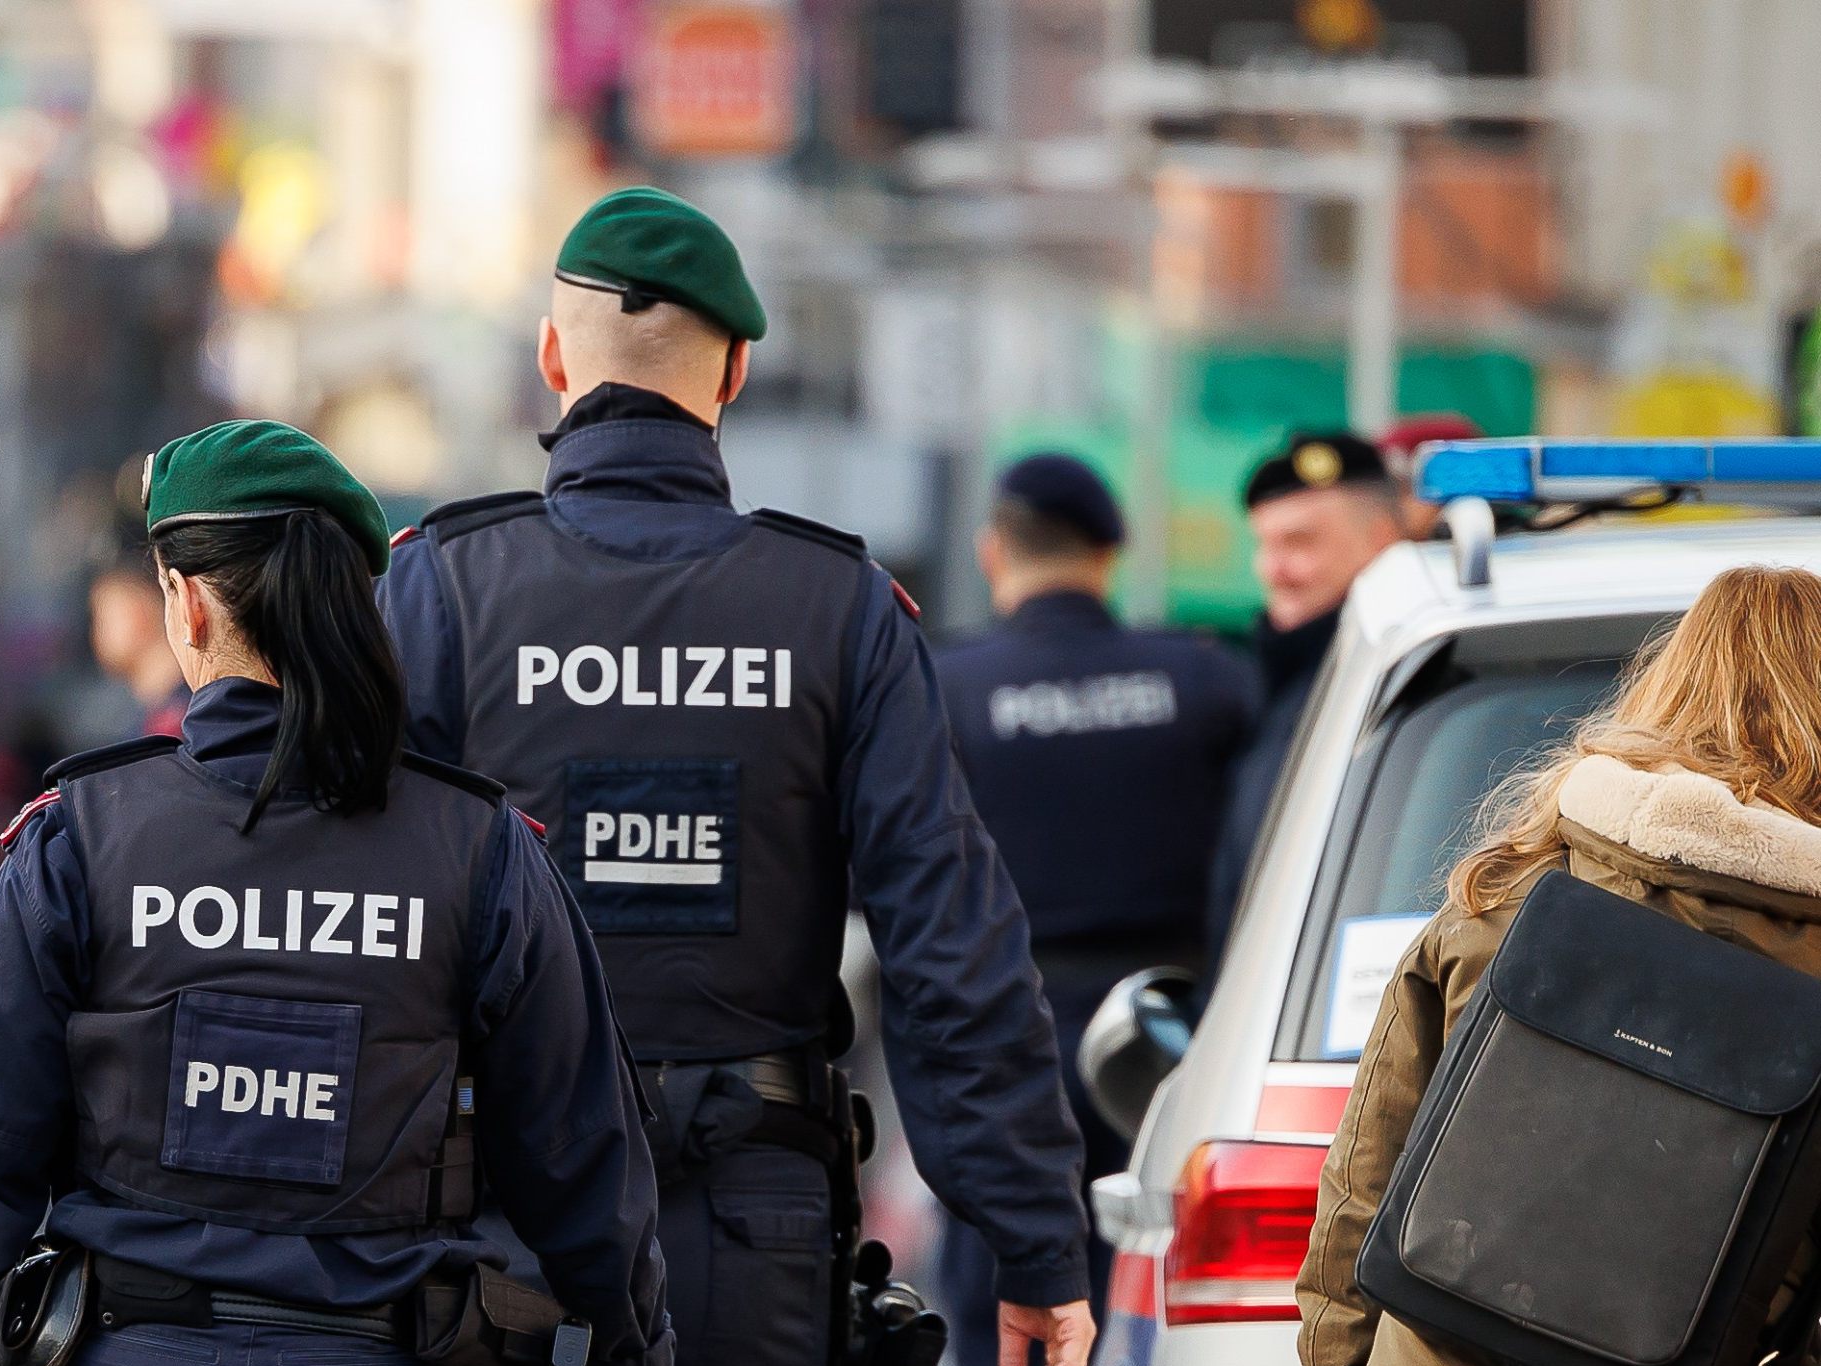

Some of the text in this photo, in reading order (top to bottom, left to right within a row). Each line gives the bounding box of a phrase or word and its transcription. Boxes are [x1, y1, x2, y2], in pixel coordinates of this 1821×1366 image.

[517, 645, 792, 708] POLIZEI
[585, 812, 724, 860] PDHE
[132, 885, 424, 959] POLIZEI
[184, 1061, 338, 1121] PDHE
